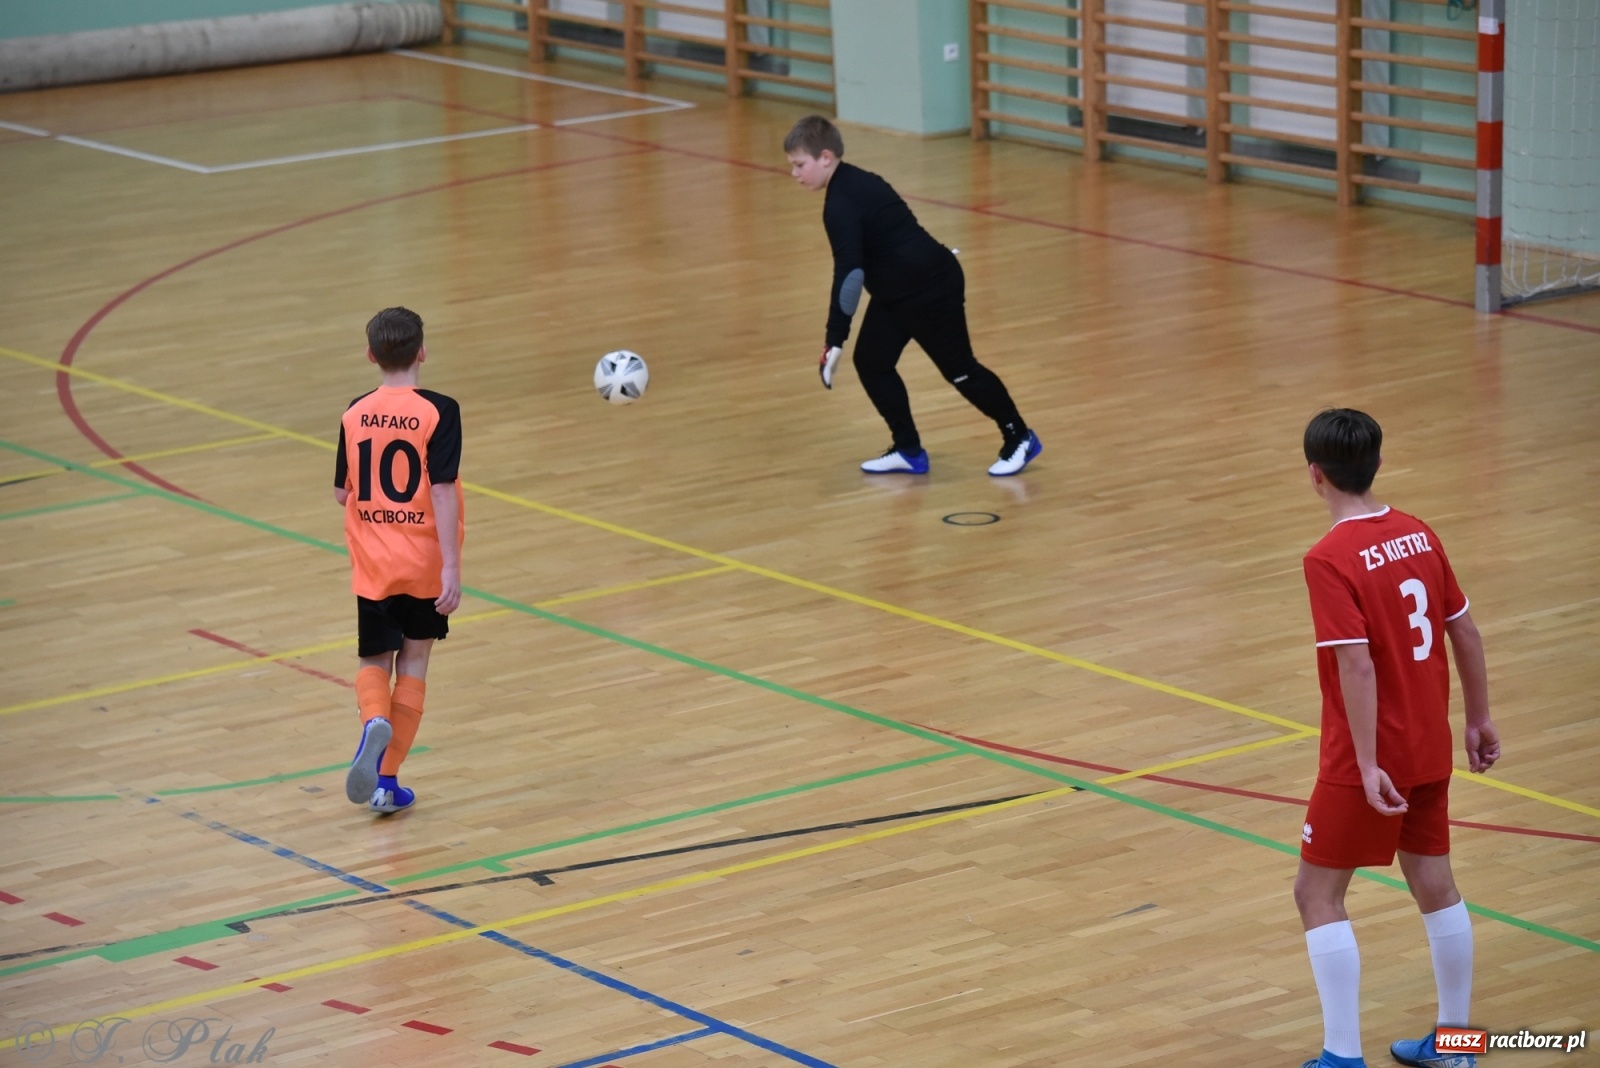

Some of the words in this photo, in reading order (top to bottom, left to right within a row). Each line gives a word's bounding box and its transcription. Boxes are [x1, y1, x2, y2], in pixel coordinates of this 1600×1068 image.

[361, 414, 420, 431] RAFAKO
[357, 438, 422, 503] 10
[1359, 545, 1385, 571] ZS
[1381, 532, 1433, 562] KIETRZ
[1399, 578, 1433, 661] 3
